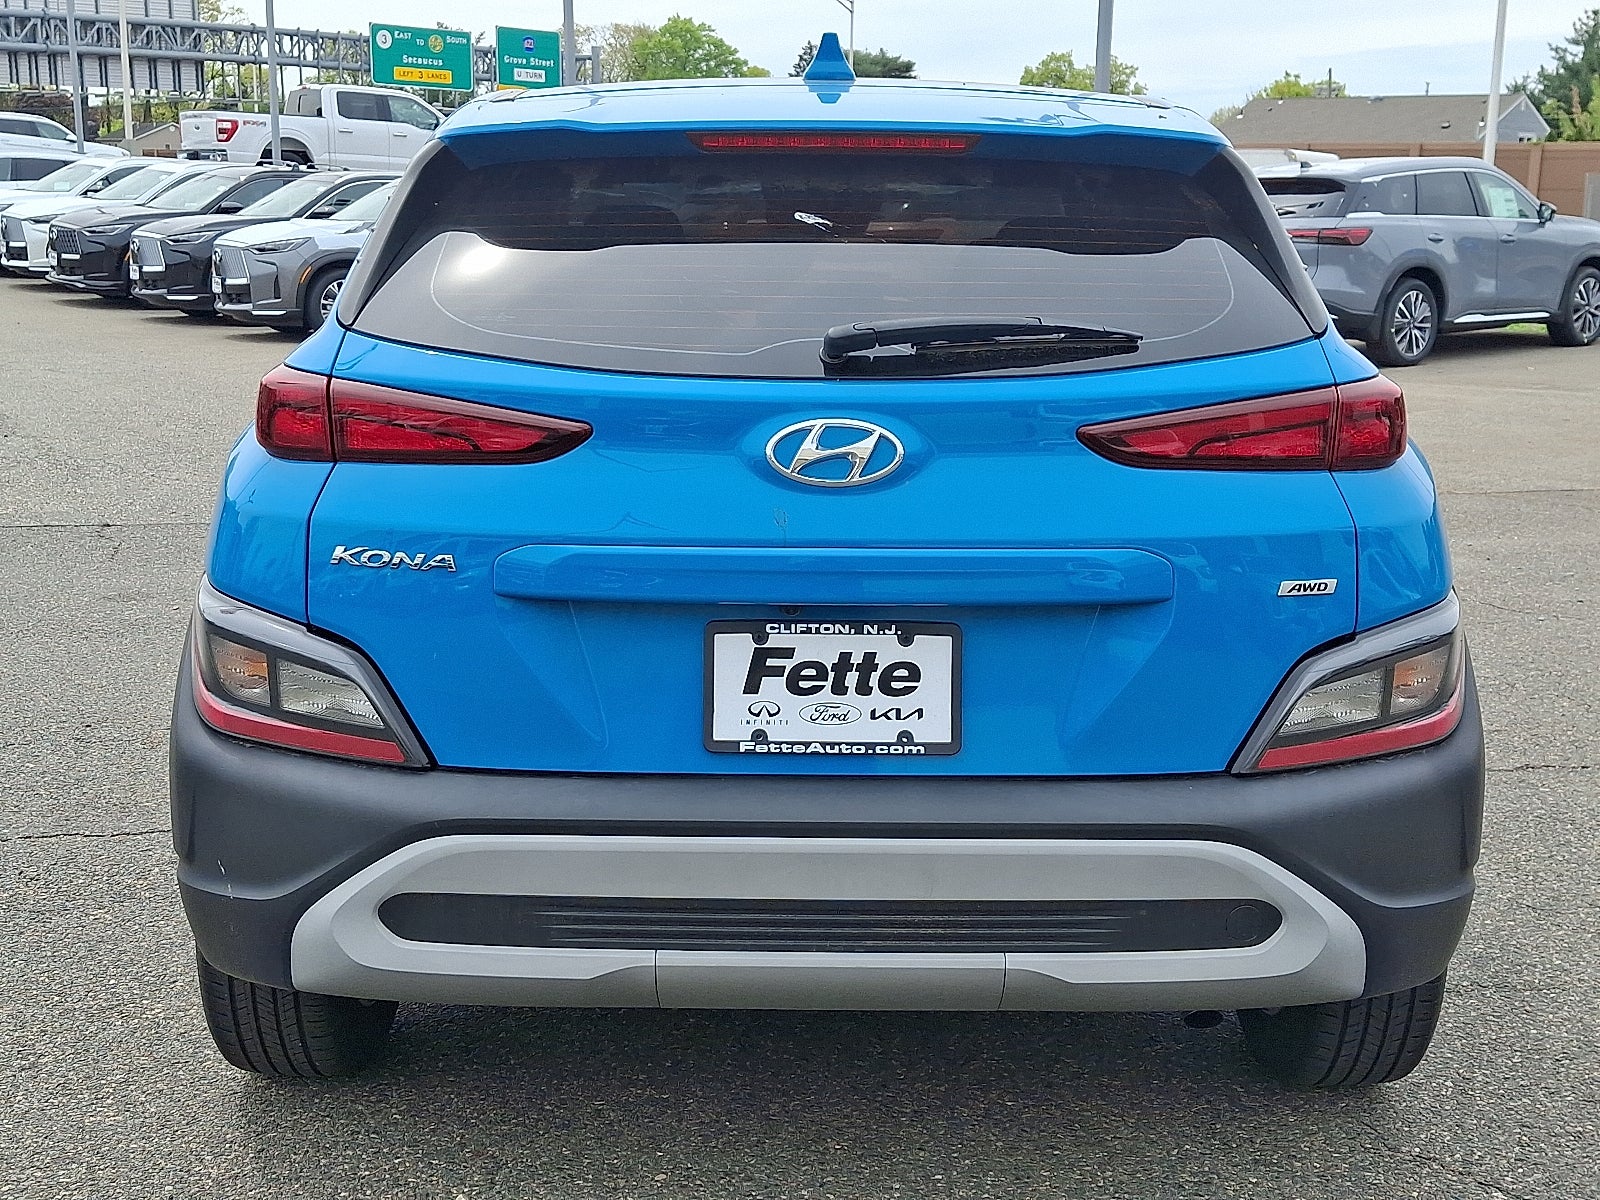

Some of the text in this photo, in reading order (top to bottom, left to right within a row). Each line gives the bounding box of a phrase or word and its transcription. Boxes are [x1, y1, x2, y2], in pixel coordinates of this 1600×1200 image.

[381, 30, 412, 45] 3 EAST
[446, 35, 468, 45] SOUTH
[402, 54, 443, 66] Secaucus
[503, 54, 555, 67] Grove Street
[399, 69, 448, 80] LEFT 3 LANES
[517, 70, 543, 79] U TURN
[329, 544, 457, 572] KONA
[1286, 582, 1329, 594] AWD
[765, 623, 902, 635] CLIFTON, N.J.
[742, 646, 922, 698] Fette
[740, 718, 790, 726] INFINITI
[809, 704, 852, 722] Ford
[739, 741, 926, 755] FetteAuto.com
